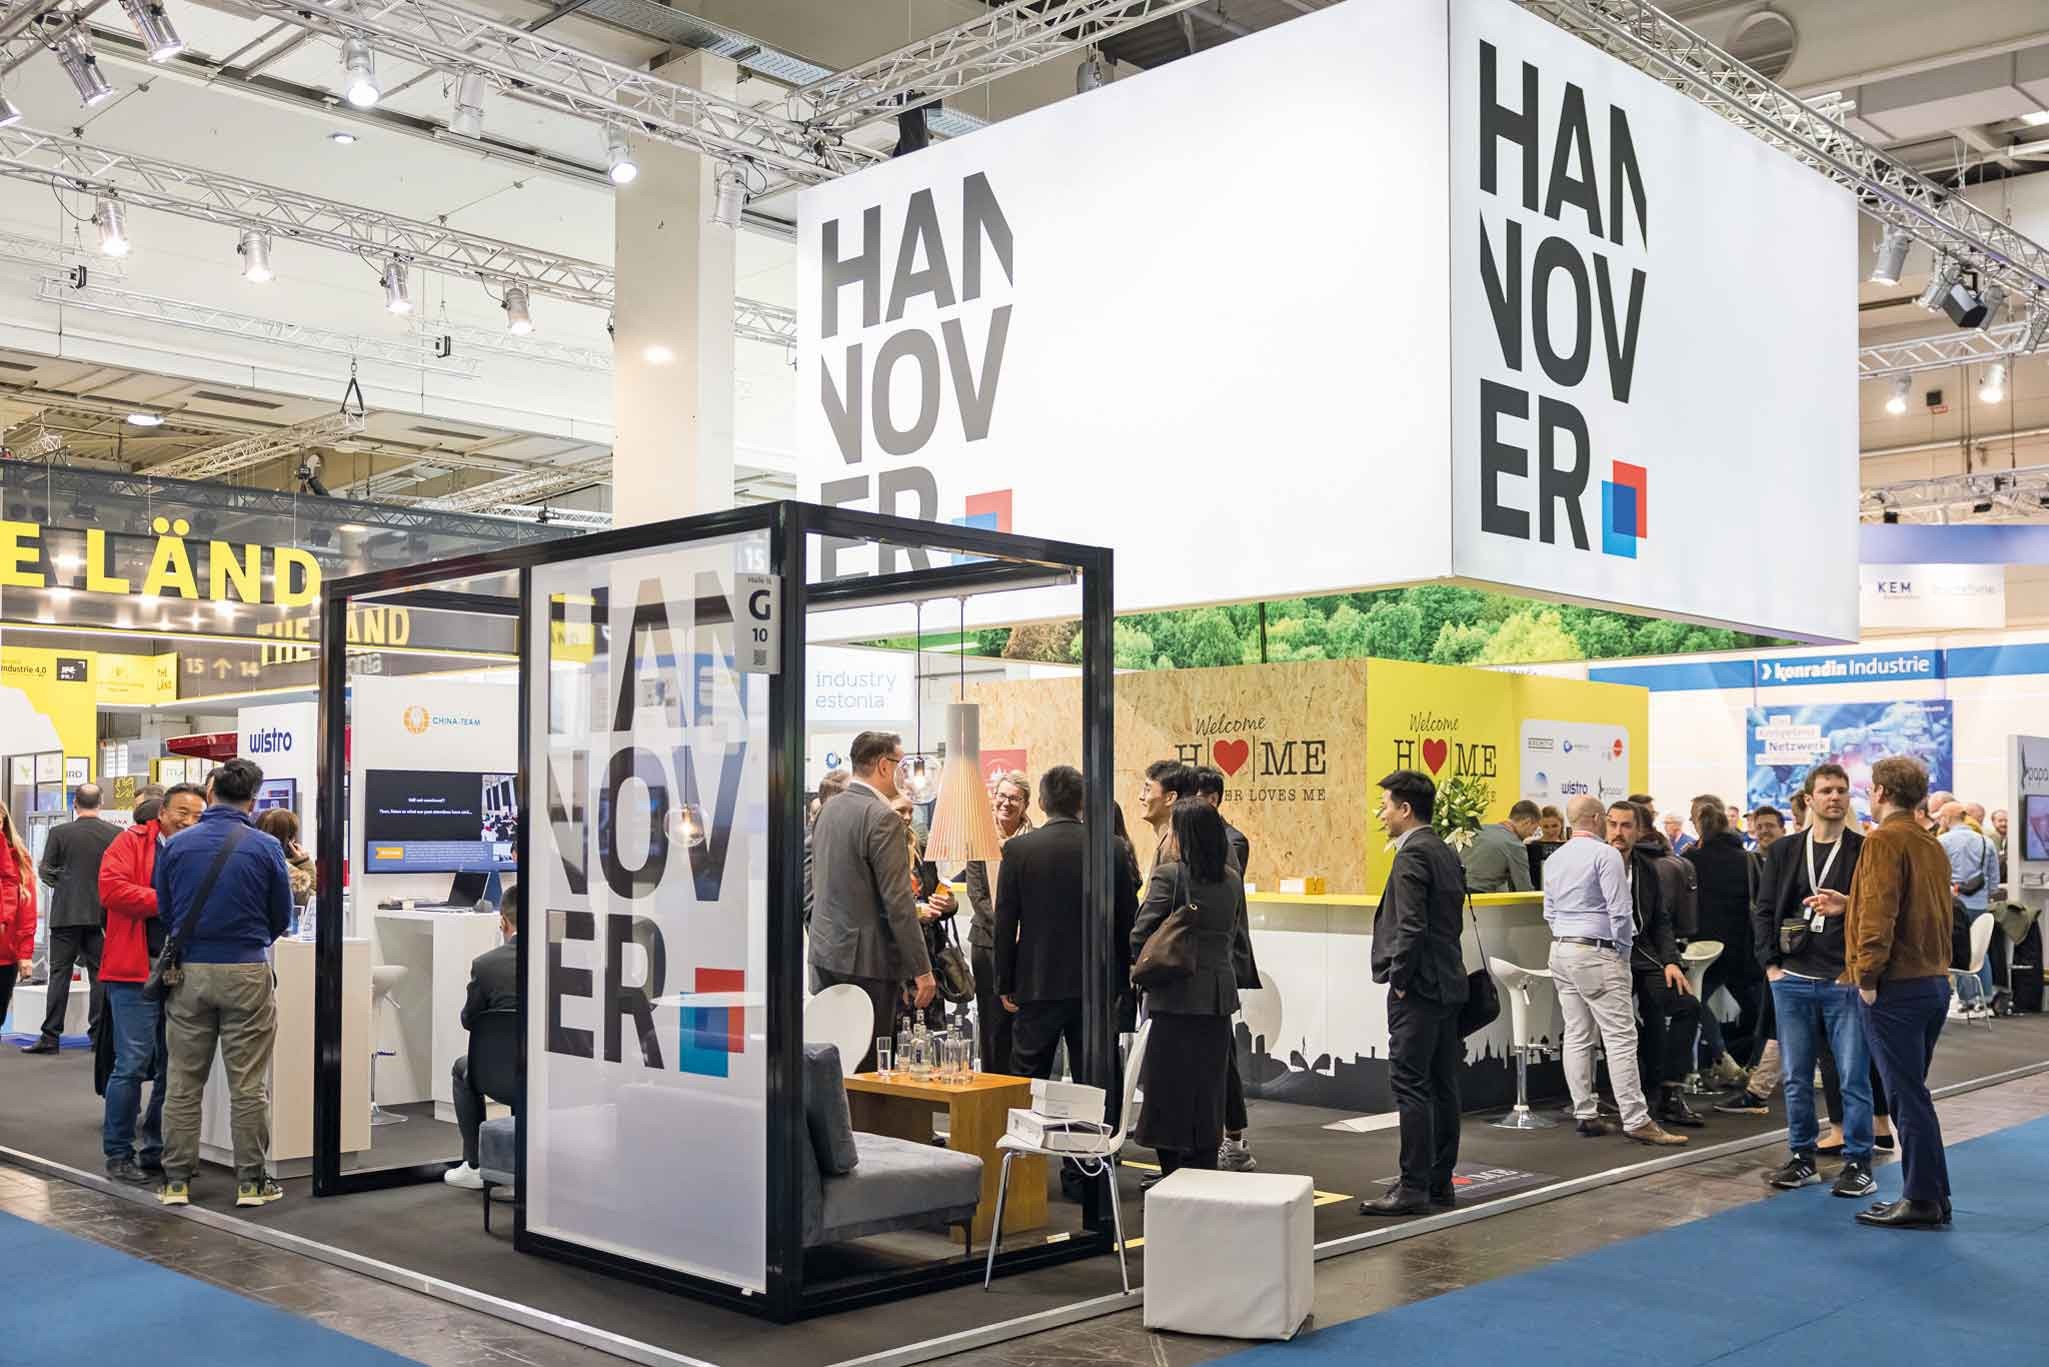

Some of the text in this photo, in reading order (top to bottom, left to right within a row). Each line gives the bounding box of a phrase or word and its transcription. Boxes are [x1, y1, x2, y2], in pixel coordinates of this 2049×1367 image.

[1479, 38, 1648, 254] HAN
[819, 171, 1013, 339] HAN
[1479, 207, 1647, 404] NOV
[819, 304, 1013, 465] NOV
[1480, 377, 1591, 551] ER
[820, 466, 938, 581] ER
[87, 516, 322, 608] LÄND
[1877, 581, 1912, 593] KEM
[748, 589, 771, 621] G
[752, 627, 769, 642] 10
[184, 657, 205, 674] 15
[1774, 659, 1847, 682] konradin
[816, 670, 897, 693] industry
[816, 691, 885, 709] estonia
[1194, 713, 1266, 736] Welcome
[1408, 711, 1459, 733] Welcome
[249, 727, 292, 753] wistro
[1224, 788, 1326, 801] ER LOVES ME
[1560, 779, 1589, 795] wistro
[544, 908, 667, 1070] ER
